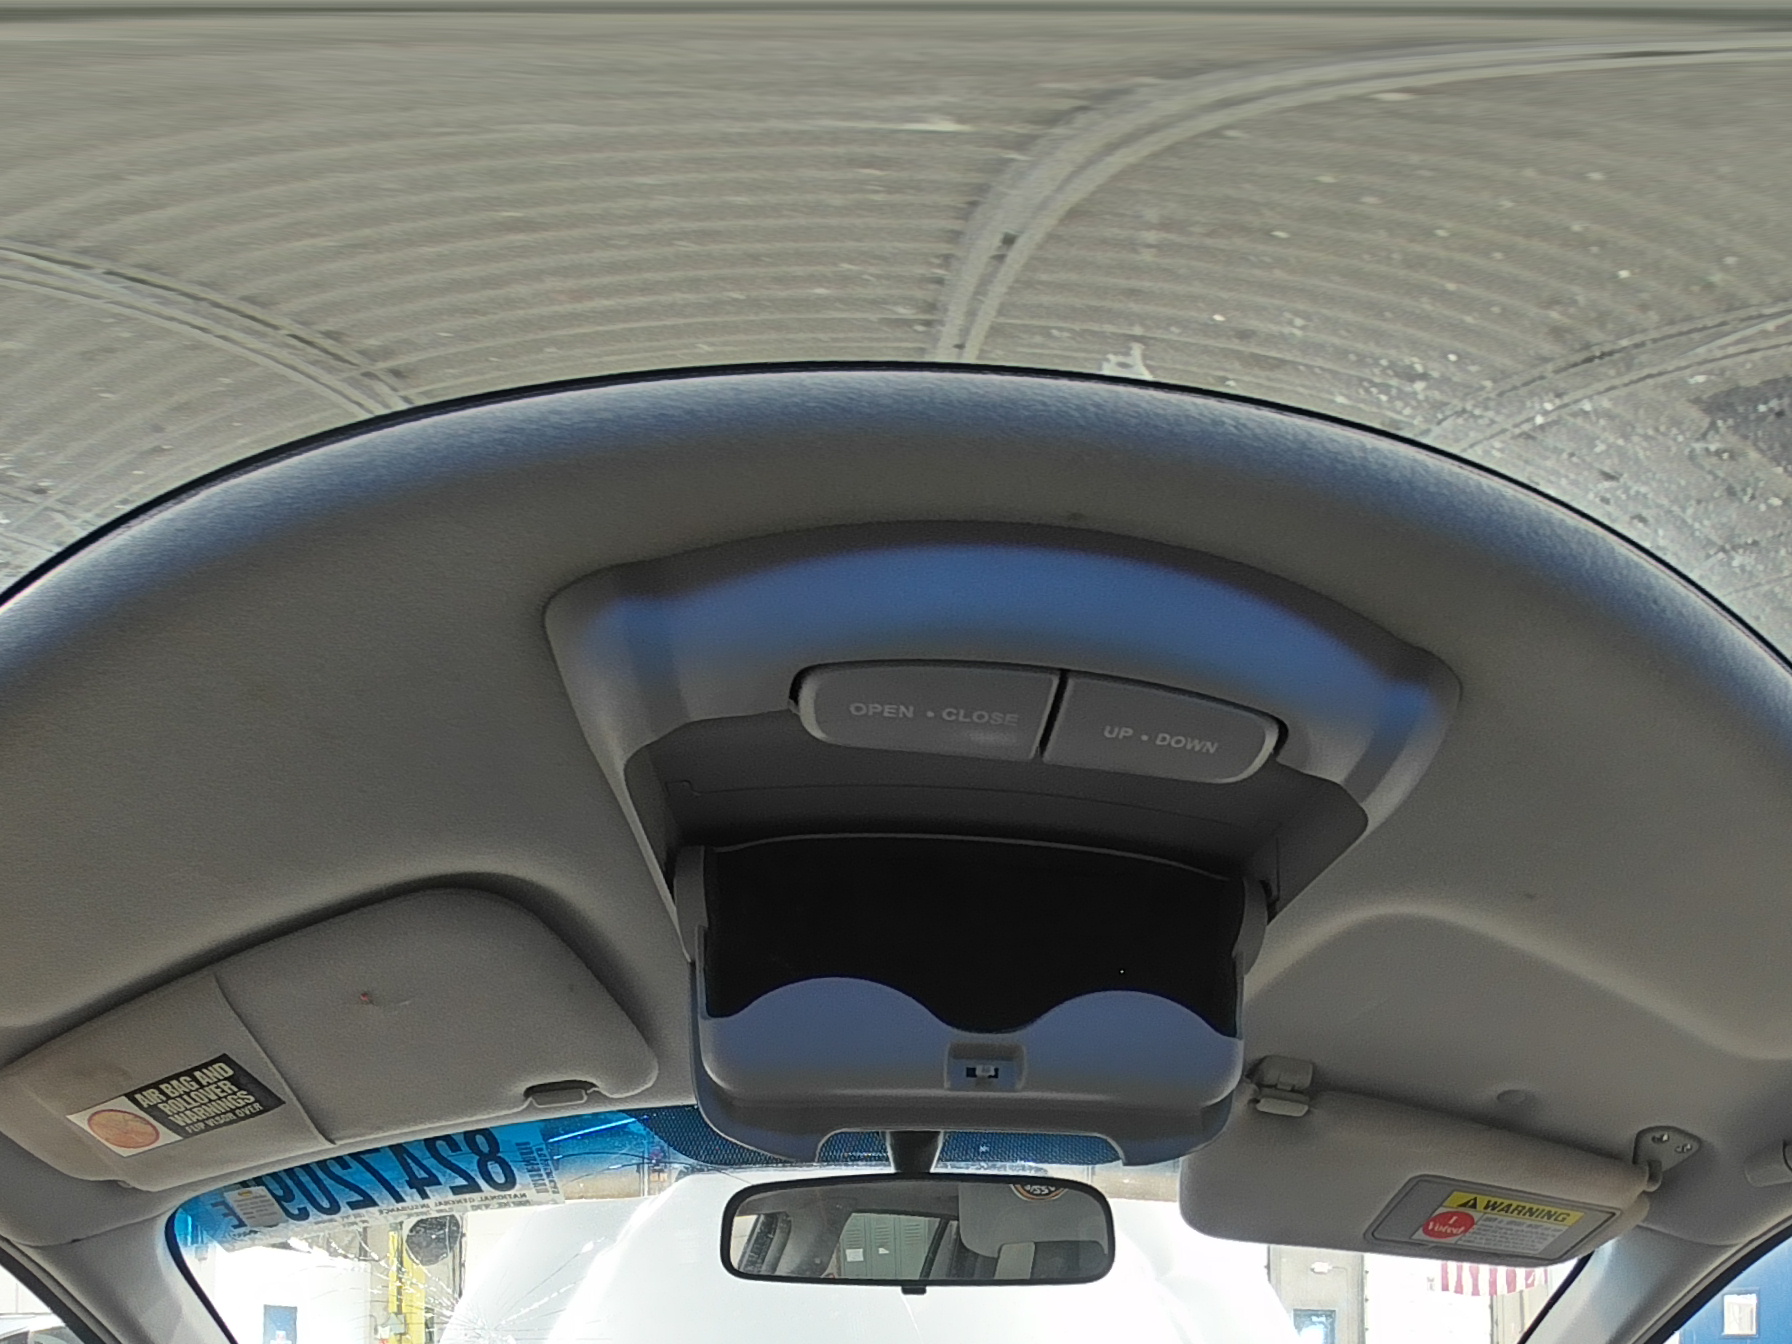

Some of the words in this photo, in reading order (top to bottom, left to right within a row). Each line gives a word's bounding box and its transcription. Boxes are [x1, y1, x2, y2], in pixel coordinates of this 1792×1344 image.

[849, 702, 914, 718] OPEN
[942, 708, 1019, 726] CLOSE
[1103, 725, 1133, 740] UP
[1156, 732, 1219, 754] DOWN
[134, 1088, 162, 1108] AIR
[160, 1076, 195, 1098] BAG
[194, 1062, 234, 1086] AND
[158, 1080, 239, 1115] ROLLOVER
[168, 1090, 255, 1127] WARNINGS
[185, 1121, 205, 1134] FLIP
[207, 1112, 235, 1128] VISOR
[236, 1102, 264, 1119] OVER
[1448, 1215, 1456, 1224] I
[1483, 1199, 1571, 1223] WARNING
[1428, 1221, 1465, 1235] Voted
